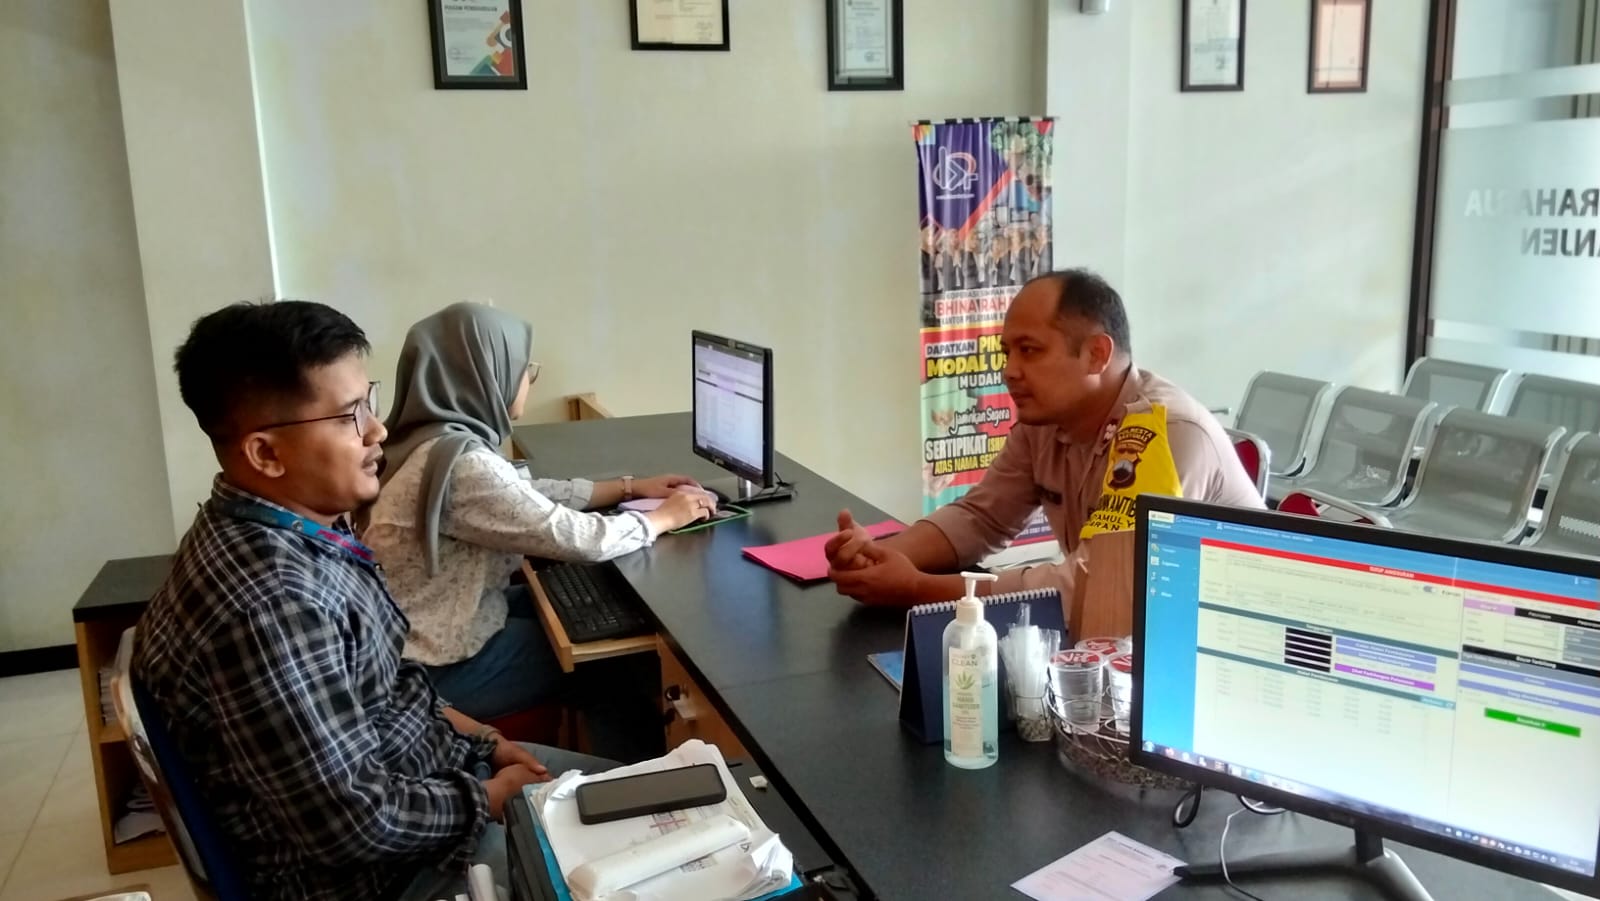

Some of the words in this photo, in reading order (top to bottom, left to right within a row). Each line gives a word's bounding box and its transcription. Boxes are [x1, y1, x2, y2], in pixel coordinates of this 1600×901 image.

[936, 299, 977, 317] BHINA
[927, 342, 975, 355] DAPATKAN
[927, 354, 988, 377] MODAL
[960, 372, 1001, 389] MUDAH
[986, 407, 1010, 427] Segera
[926, 434, 988, 461] SERTIPIKAT
[934, 460, 953, 475] ATAS
[954, 455, 979, 472] NAMA
[952, 658, 978, 667] CLEAN
